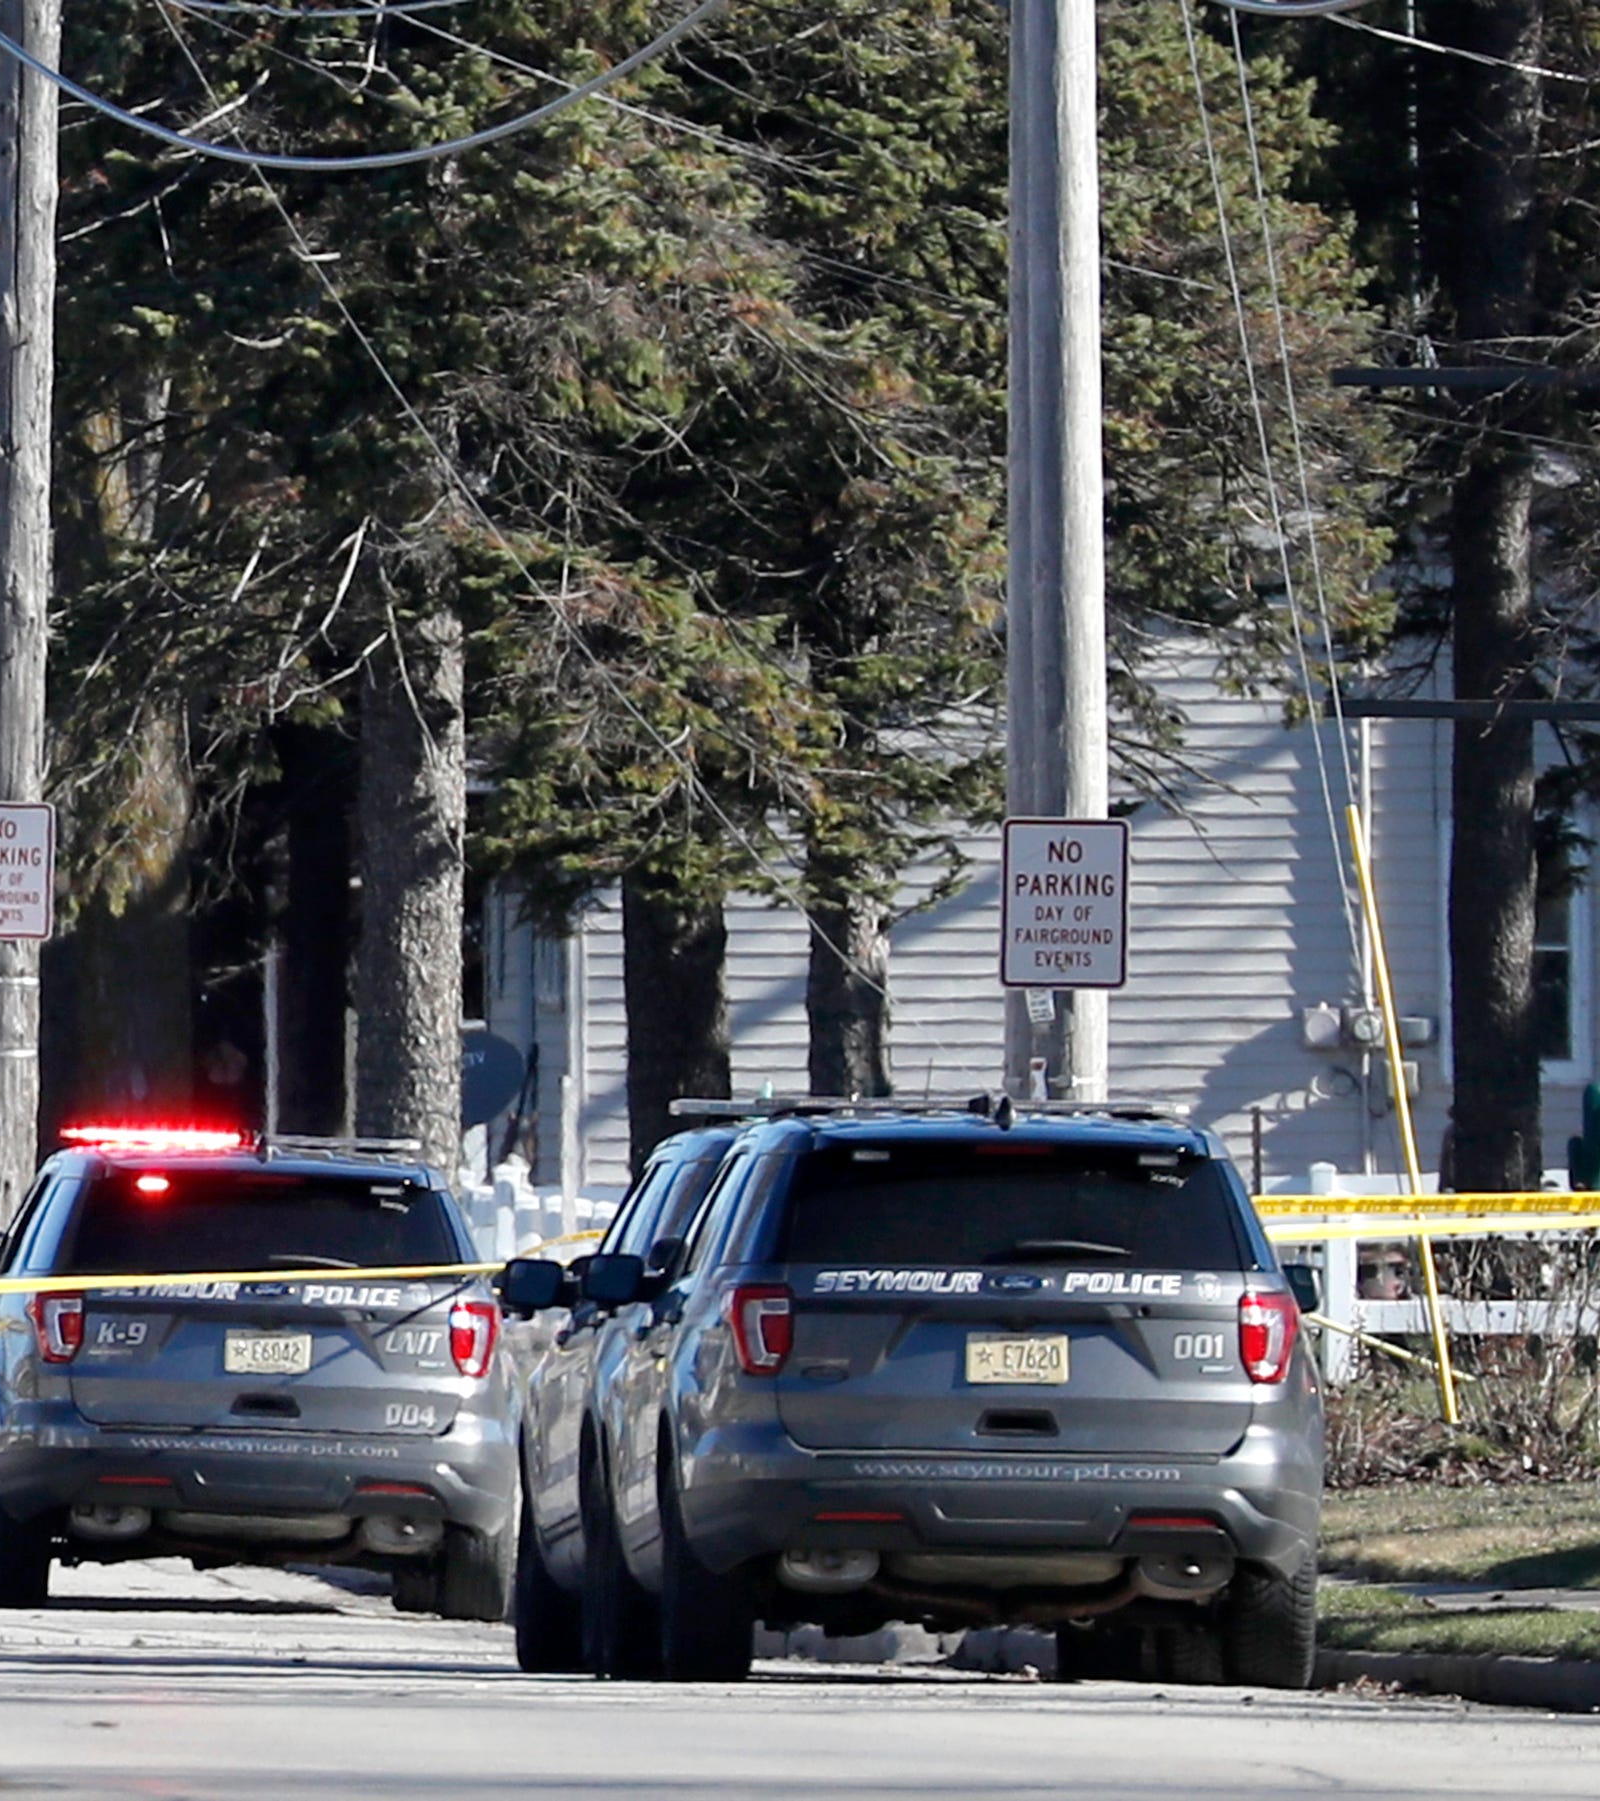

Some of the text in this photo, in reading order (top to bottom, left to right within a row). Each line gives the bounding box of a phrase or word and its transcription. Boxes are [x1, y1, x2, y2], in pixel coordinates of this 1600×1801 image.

[1048, 841, 1082, 863] NO
[8, 873, 25, 885] OF
[1015, 874, 1115, 897] PARKING
[1035, 906, 1093, 921] DAY OF
[1015, 928, 1113, 944] FAIRGROUND
[1035, 952, 1093, 967] EVENTS
[813, 1271, 983, 1293] SEYMOUR
[1063, 1272, 1182, 1295] POLICE
[301, 1285, 401, 1306] POLICE
[97, 1322, 147, 1345] K-9
[1003, 1344, 1061, 1370] E7620
[1174, 1334, 1224, 1359] 001
[386, 1404, 437, 1428] 004
[129, 1436, 400, 1459] www.seymour-pd.com
[854, 1462, 1181, 1483] www.seymour-pd.com
